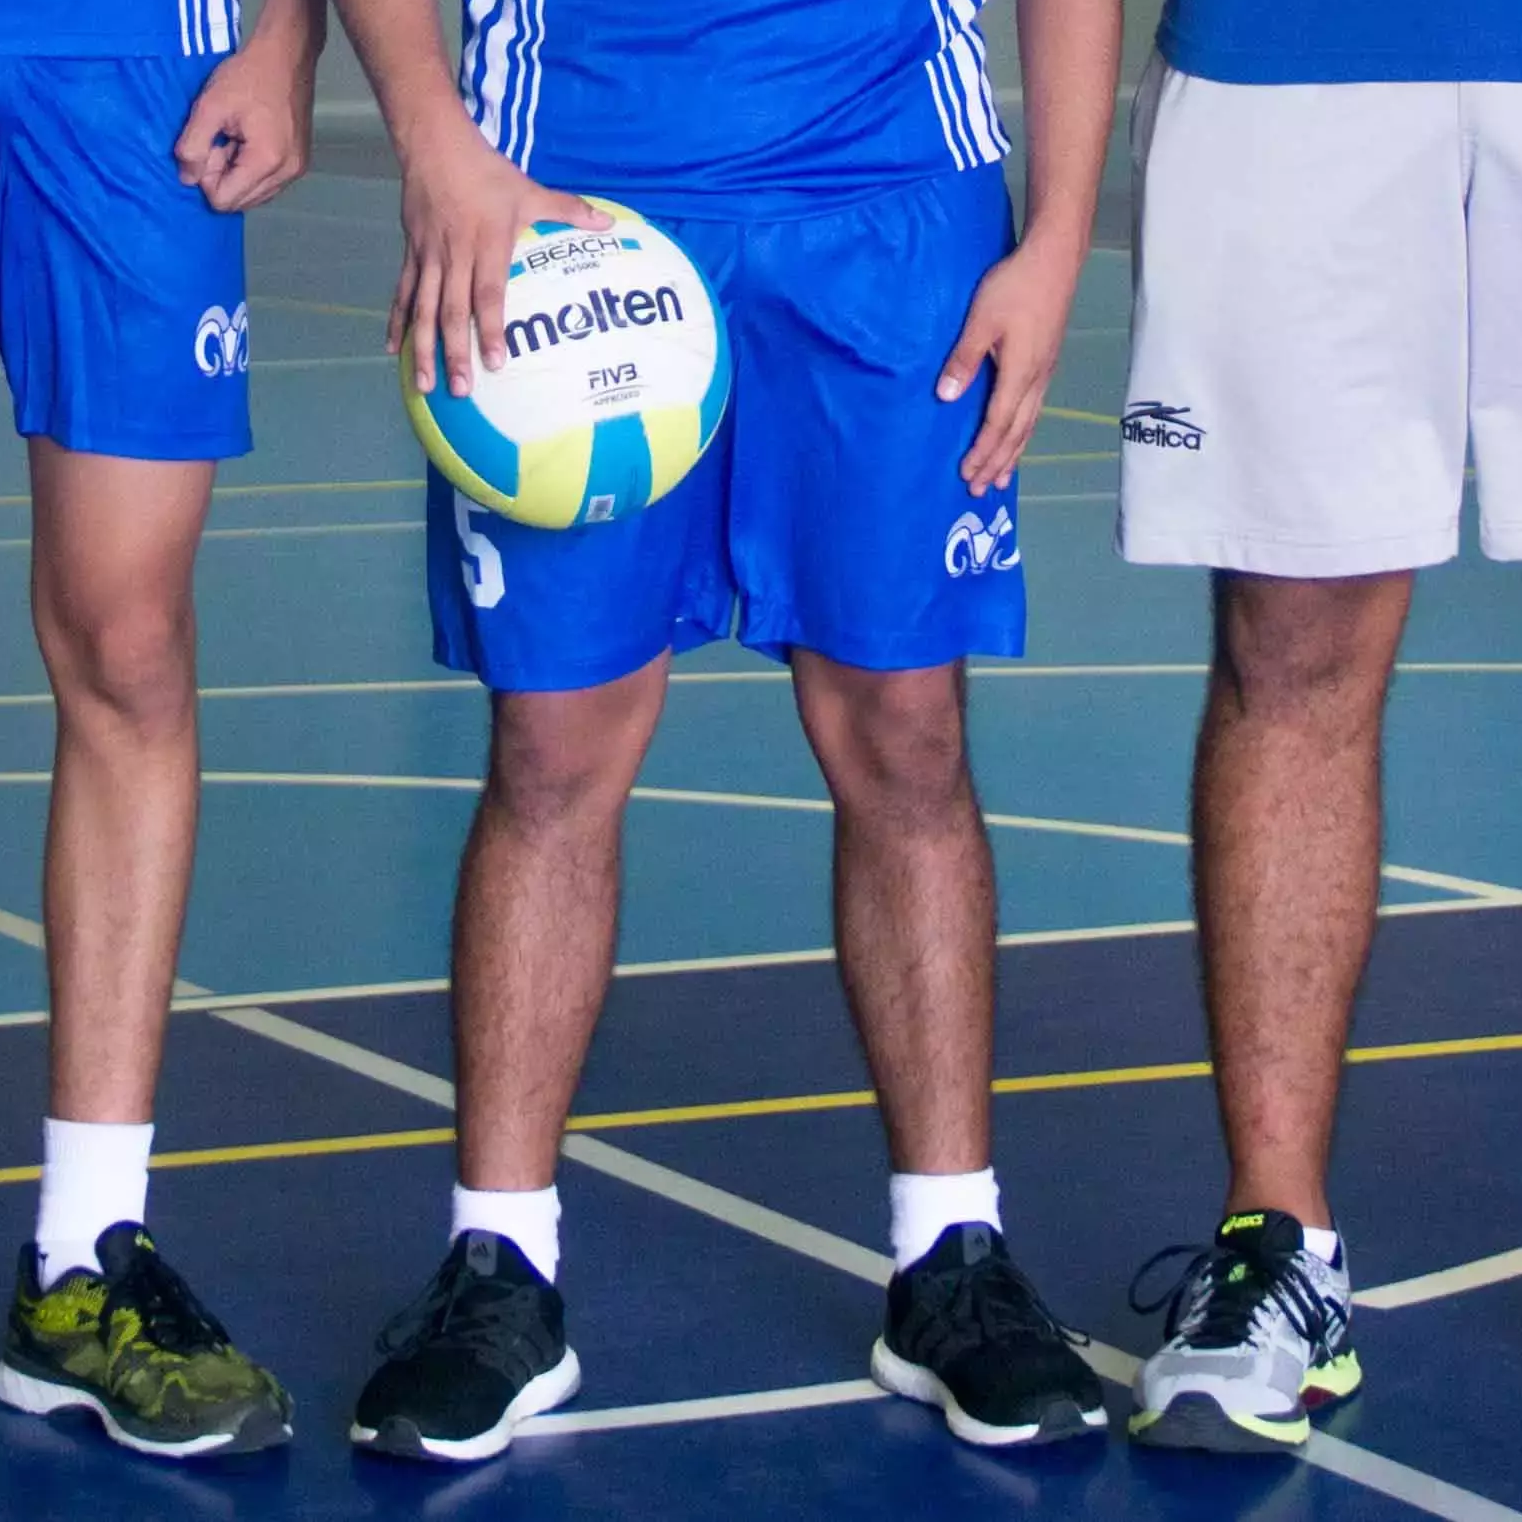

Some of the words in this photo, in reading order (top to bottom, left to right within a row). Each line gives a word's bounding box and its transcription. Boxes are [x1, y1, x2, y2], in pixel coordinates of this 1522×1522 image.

[526, 237, 620, 270] BEACH
[504, 285, 684, 359] molten
[588, 362, 638, 390] FIVB
[1121, 420, 1201, 451] atletica
[454, 486, 506, 609] 5
